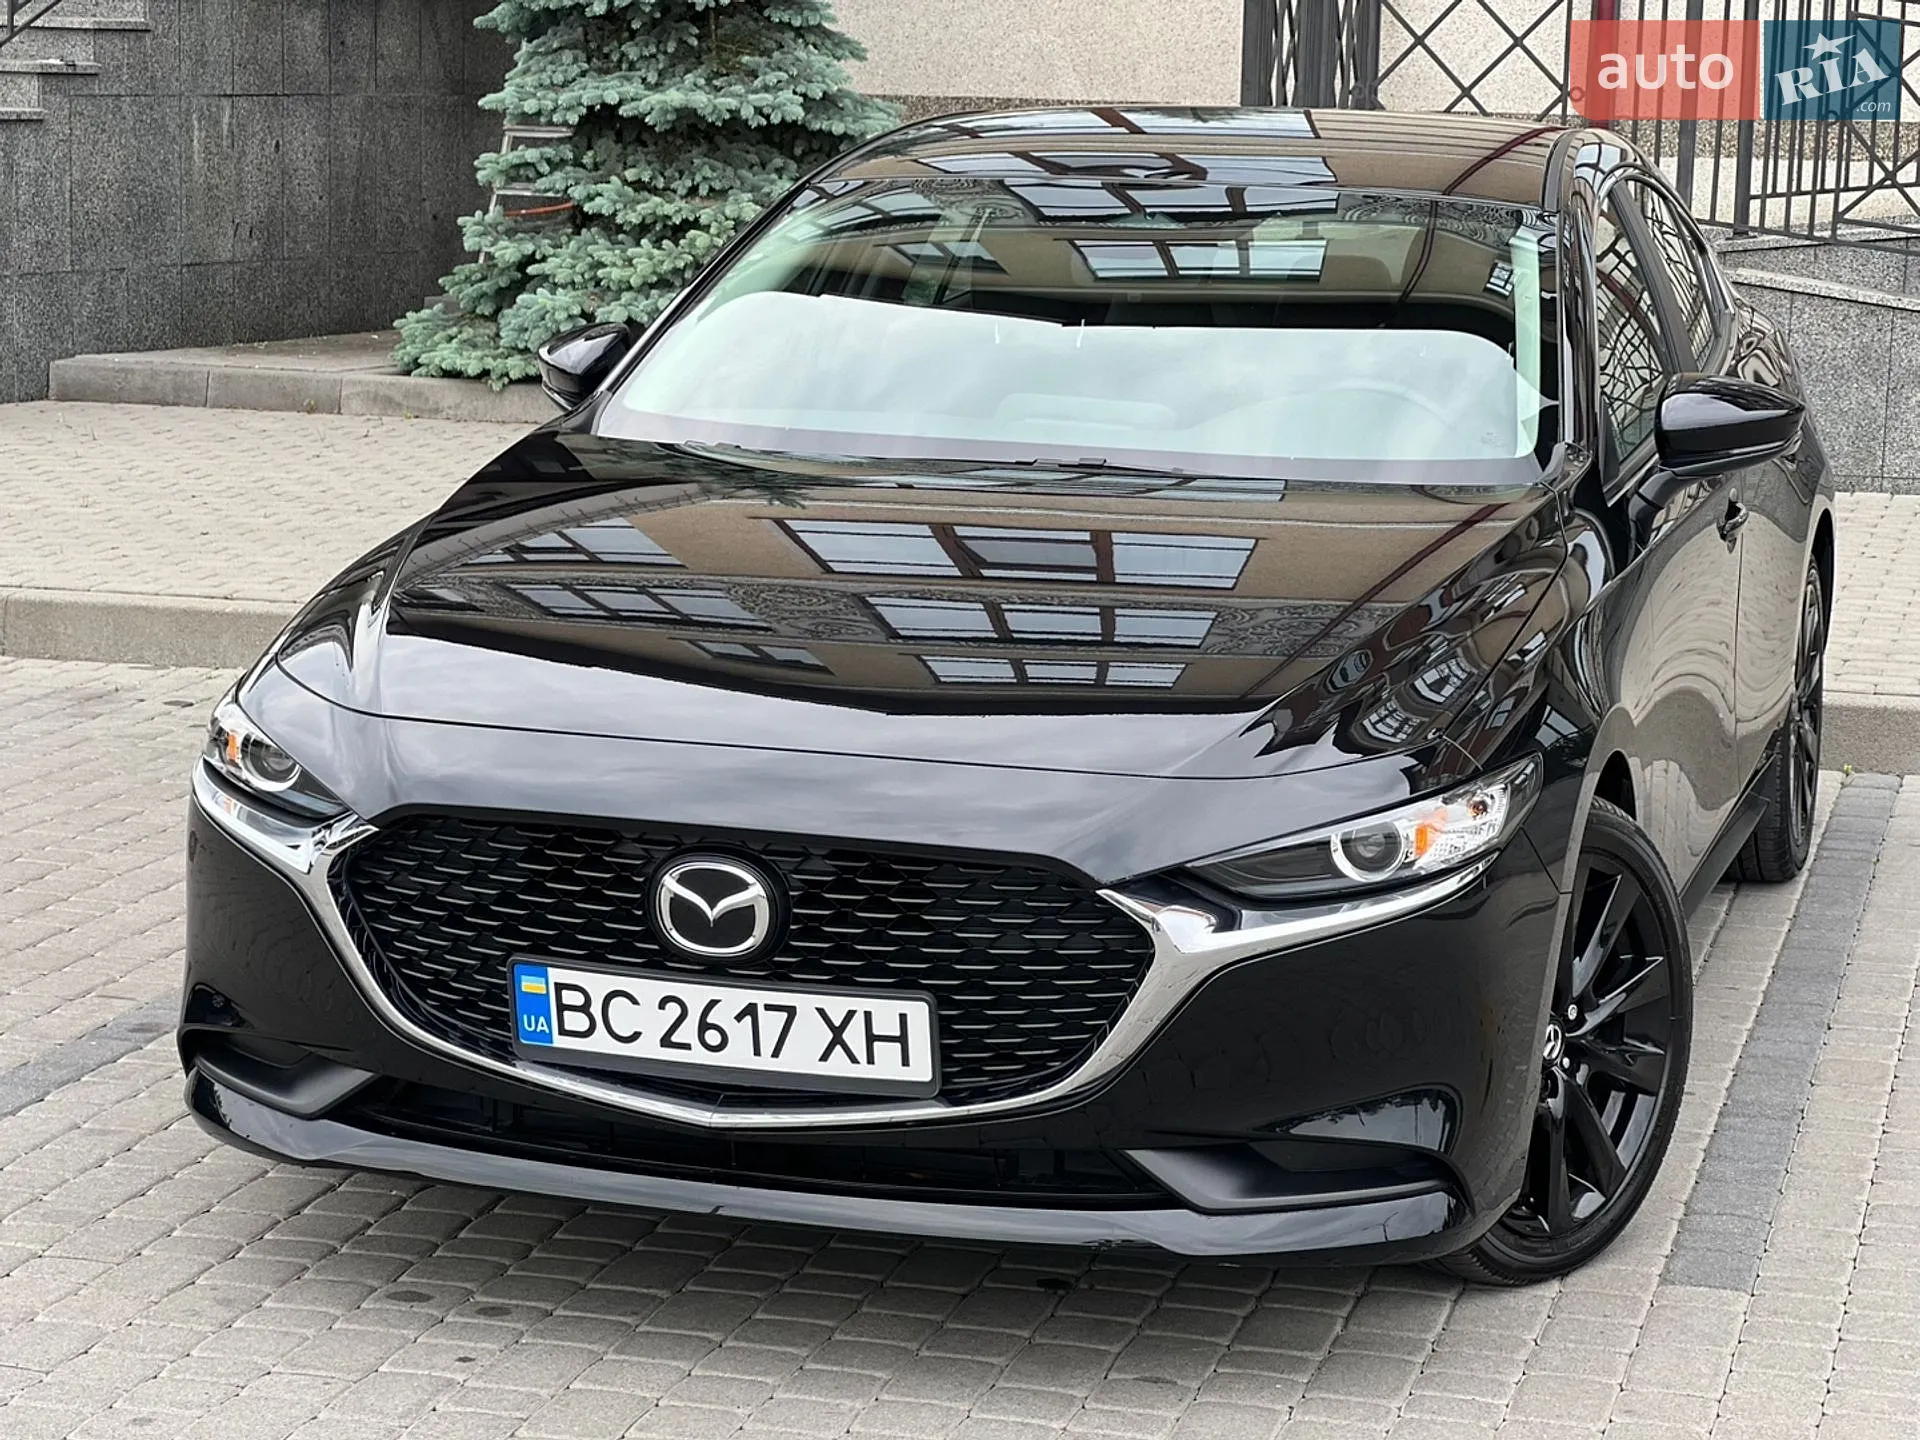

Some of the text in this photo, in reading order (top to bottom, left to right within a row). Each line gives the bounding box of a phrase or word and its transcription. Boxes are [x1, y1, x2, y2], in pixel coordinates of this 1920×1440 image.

[523, 1014, 549, 1035] UA
[554, 982, 910, 1067] BC 2617 XH
